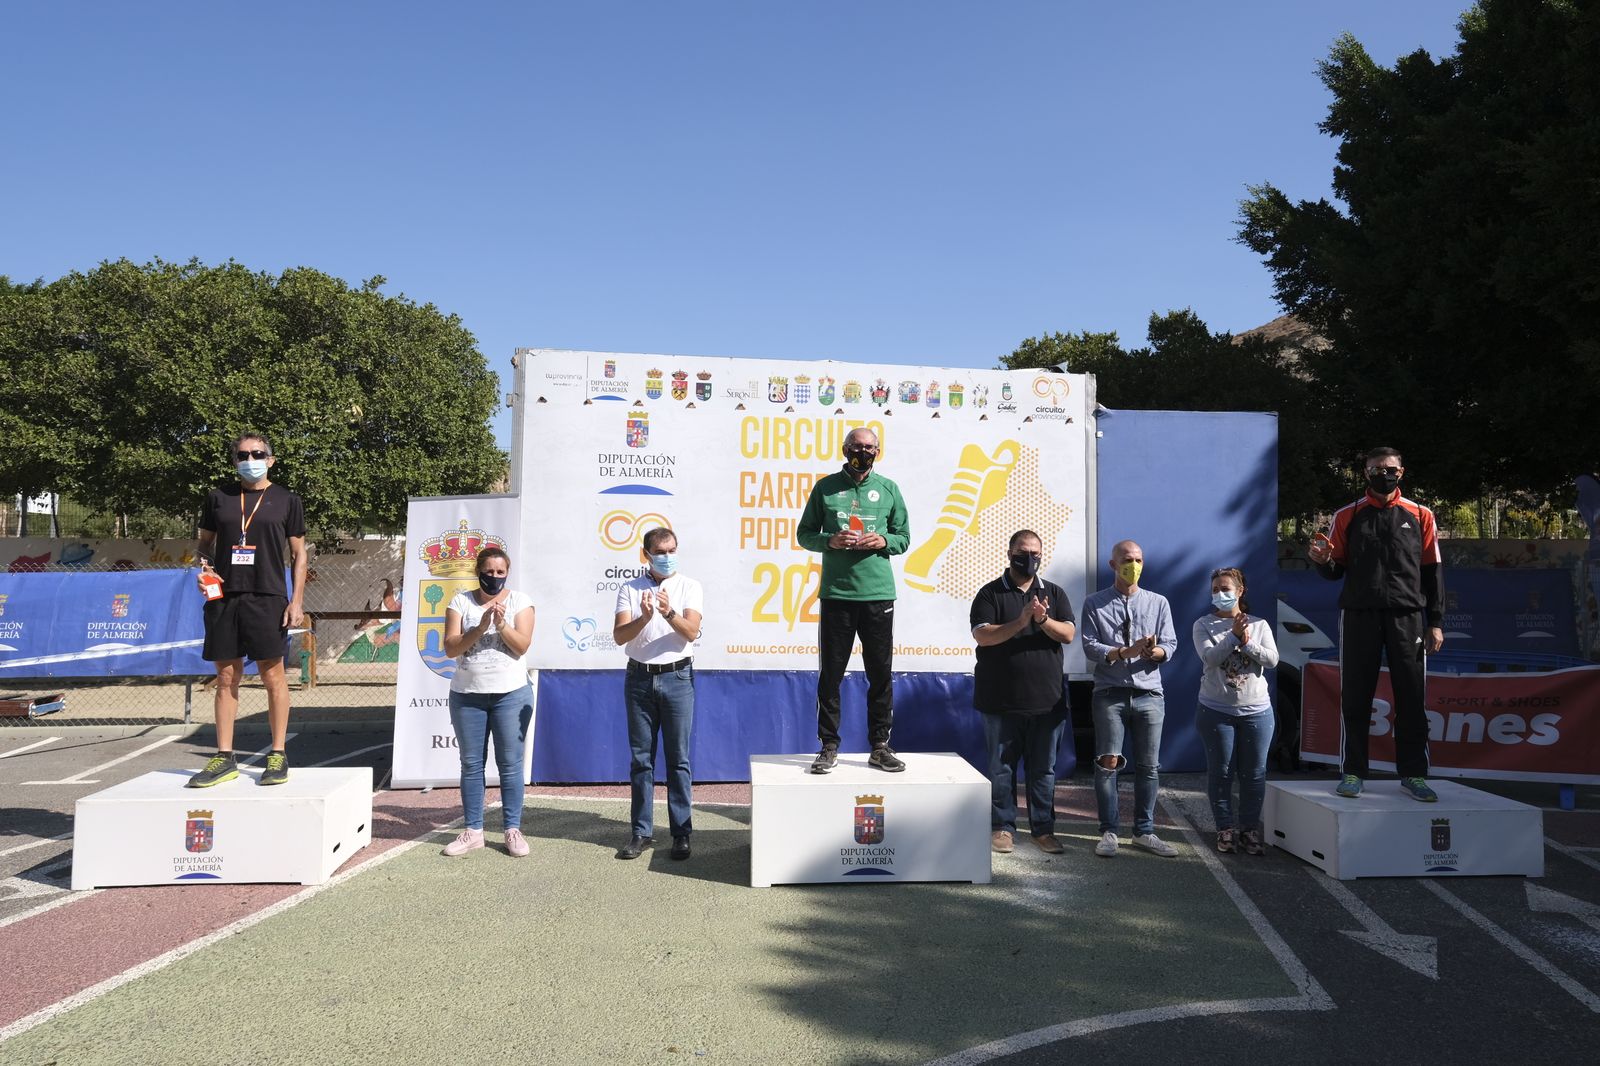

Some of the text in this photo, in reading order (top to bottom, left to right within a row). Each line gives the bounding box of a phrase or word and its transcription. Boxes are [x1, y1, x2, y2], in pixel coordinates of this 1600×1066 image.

[1035, 406, 1066, 414] circuitos
[598, 453, 676, 465] DIPUTACIÓN
[599, 466, 674, 479] DE ALMERÍA
[739, 471, 829, 509] CARR
[87, 621, 147, 631] DIPUTACIÓN
[102, 630, 144, 639] ALMERÍA
[409, 698, 449, 707] AYUNT
[1437, 696, 1561, 707] SPORT & SHOES
[1369, 698, 1562, 746] Banes
[840, 847, 895, 856] DIPUTACIÓN
[173, 855, 223, 864] DIPUTACIÓN
[855, 856, 894, 865] ALMERÍA
